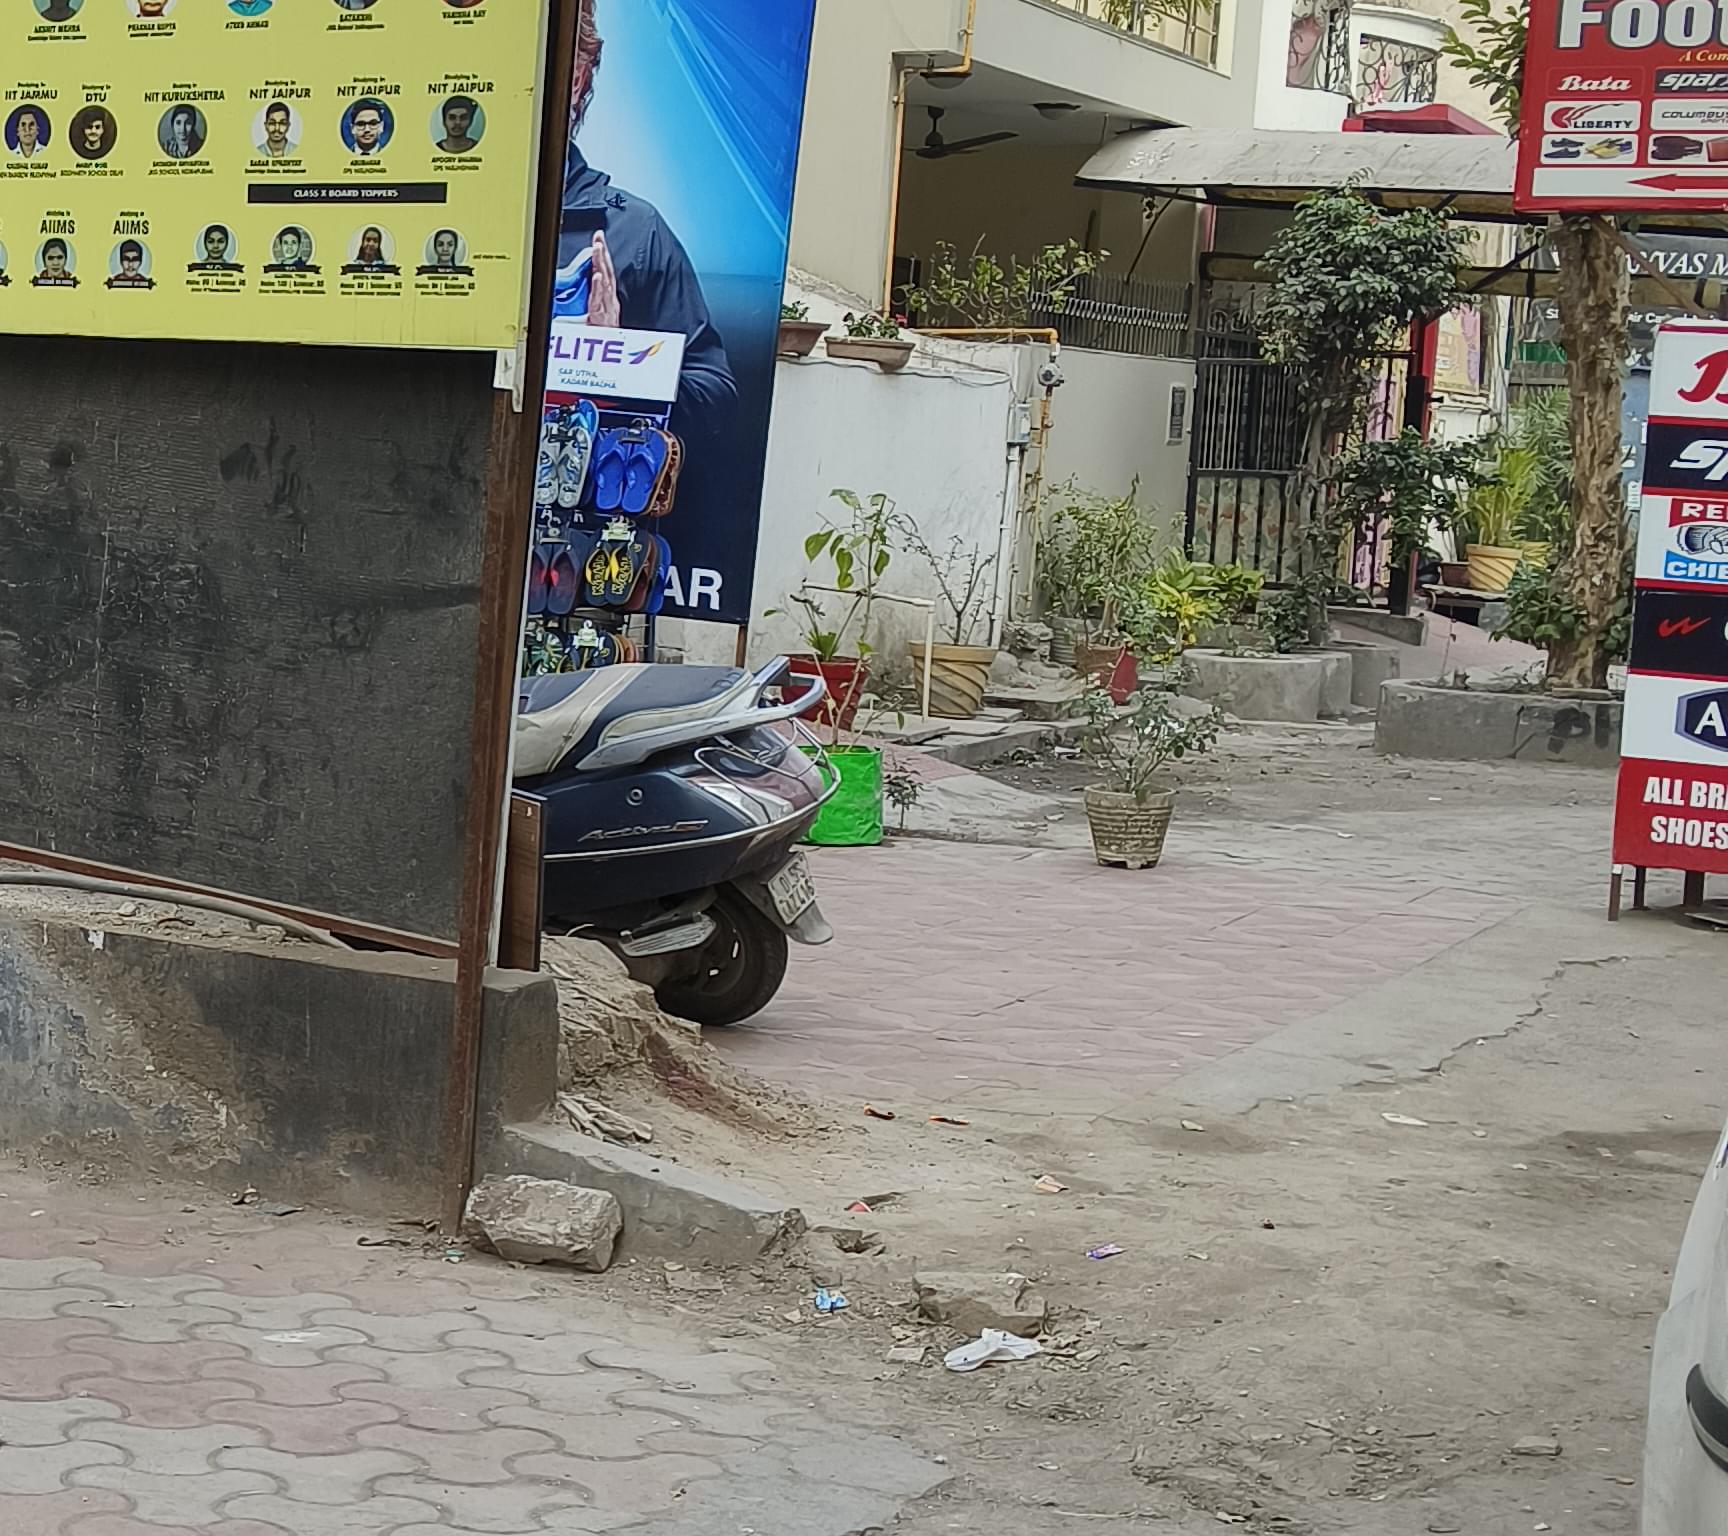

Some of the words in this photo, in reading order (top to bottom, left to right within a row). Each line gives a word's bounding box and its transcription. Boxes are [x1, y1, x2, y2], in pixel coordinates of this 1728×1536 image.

[428, 83, 448, 94] NIT
[451, 82, 494, 93] JAIPUR
[1558, 75, 1632, 92] Bata
[249, 89, 268, 99] NIT
[272, 88, 311, 99] JAIPUR
[337, 86, 357, 96] NIT
[360, 85, 401, 96] JAIPUR
[85, 92, 107, 102] DTU
[144, 92, 159, 102] NIT
[1573, 120, 1633, 129] LIBERTY
[293, 189, 319, 198] CLASS
[40, 219, 75, 235] AIIMS
[113, 219, 150, 235] AIIMS
[1643, 777, 1685, 806] ALL
[1650, 816, 1728, 850] SHOES
